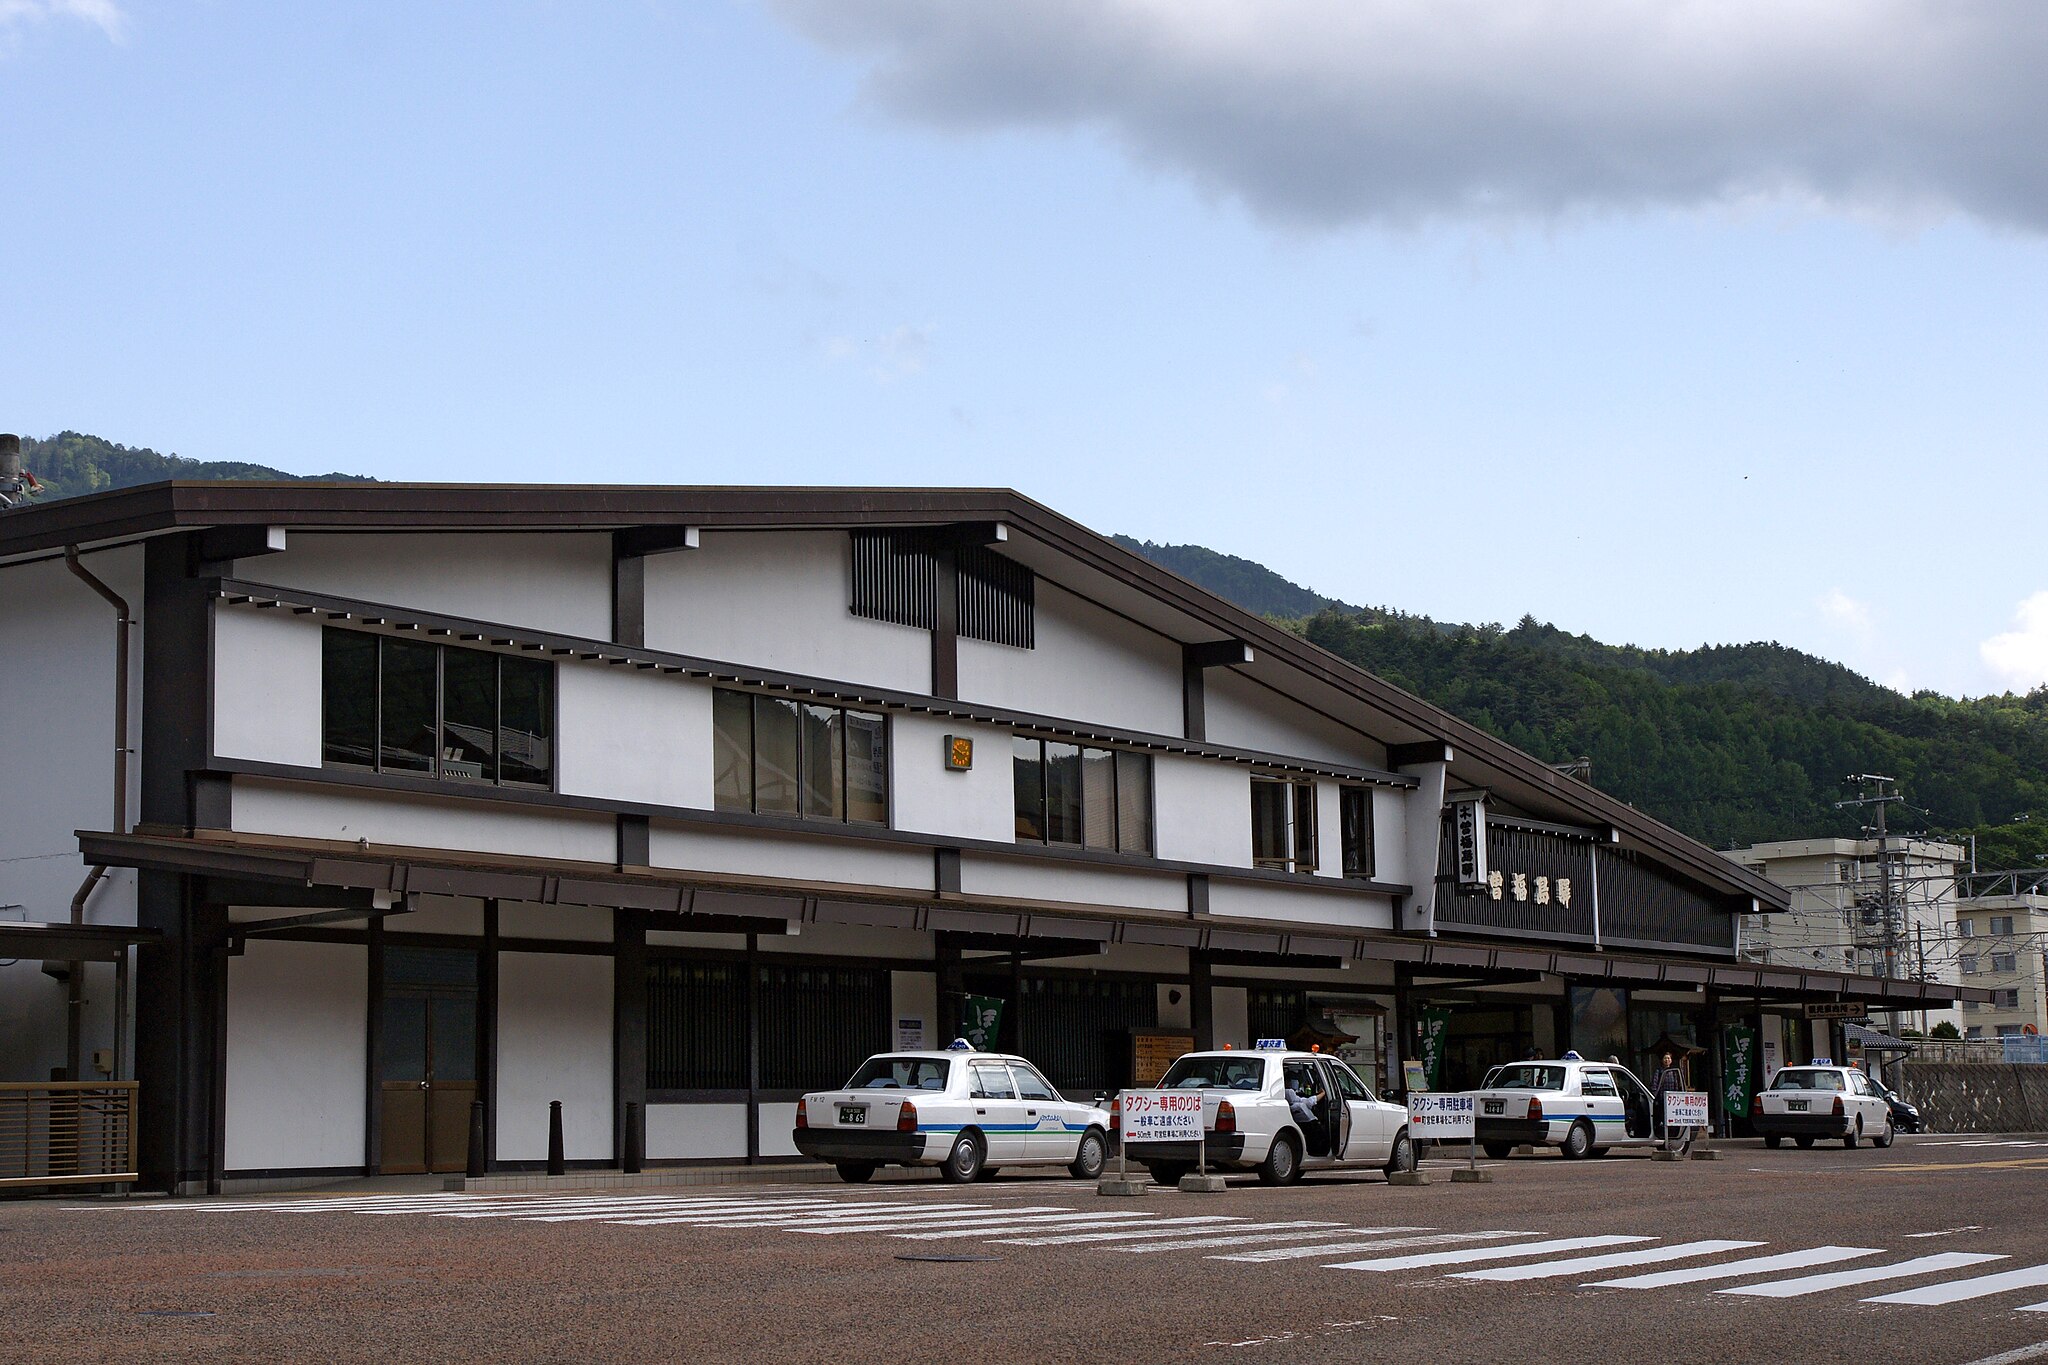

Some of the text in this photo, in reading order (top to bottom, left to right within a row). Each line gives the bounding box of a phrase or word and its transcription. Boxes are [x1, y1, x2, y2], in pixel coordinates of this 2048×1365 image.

[1125, 1096, 1201, 1111] タクシー専用のりば
[1412, 1098, 1473, 1111] タクシー専用駐車場
[1134, 1115, 1194, 1126] 一般車ご遠慮ください
[1421, 1115, 1473, 1125] 町営駐車場をご利用下さい
